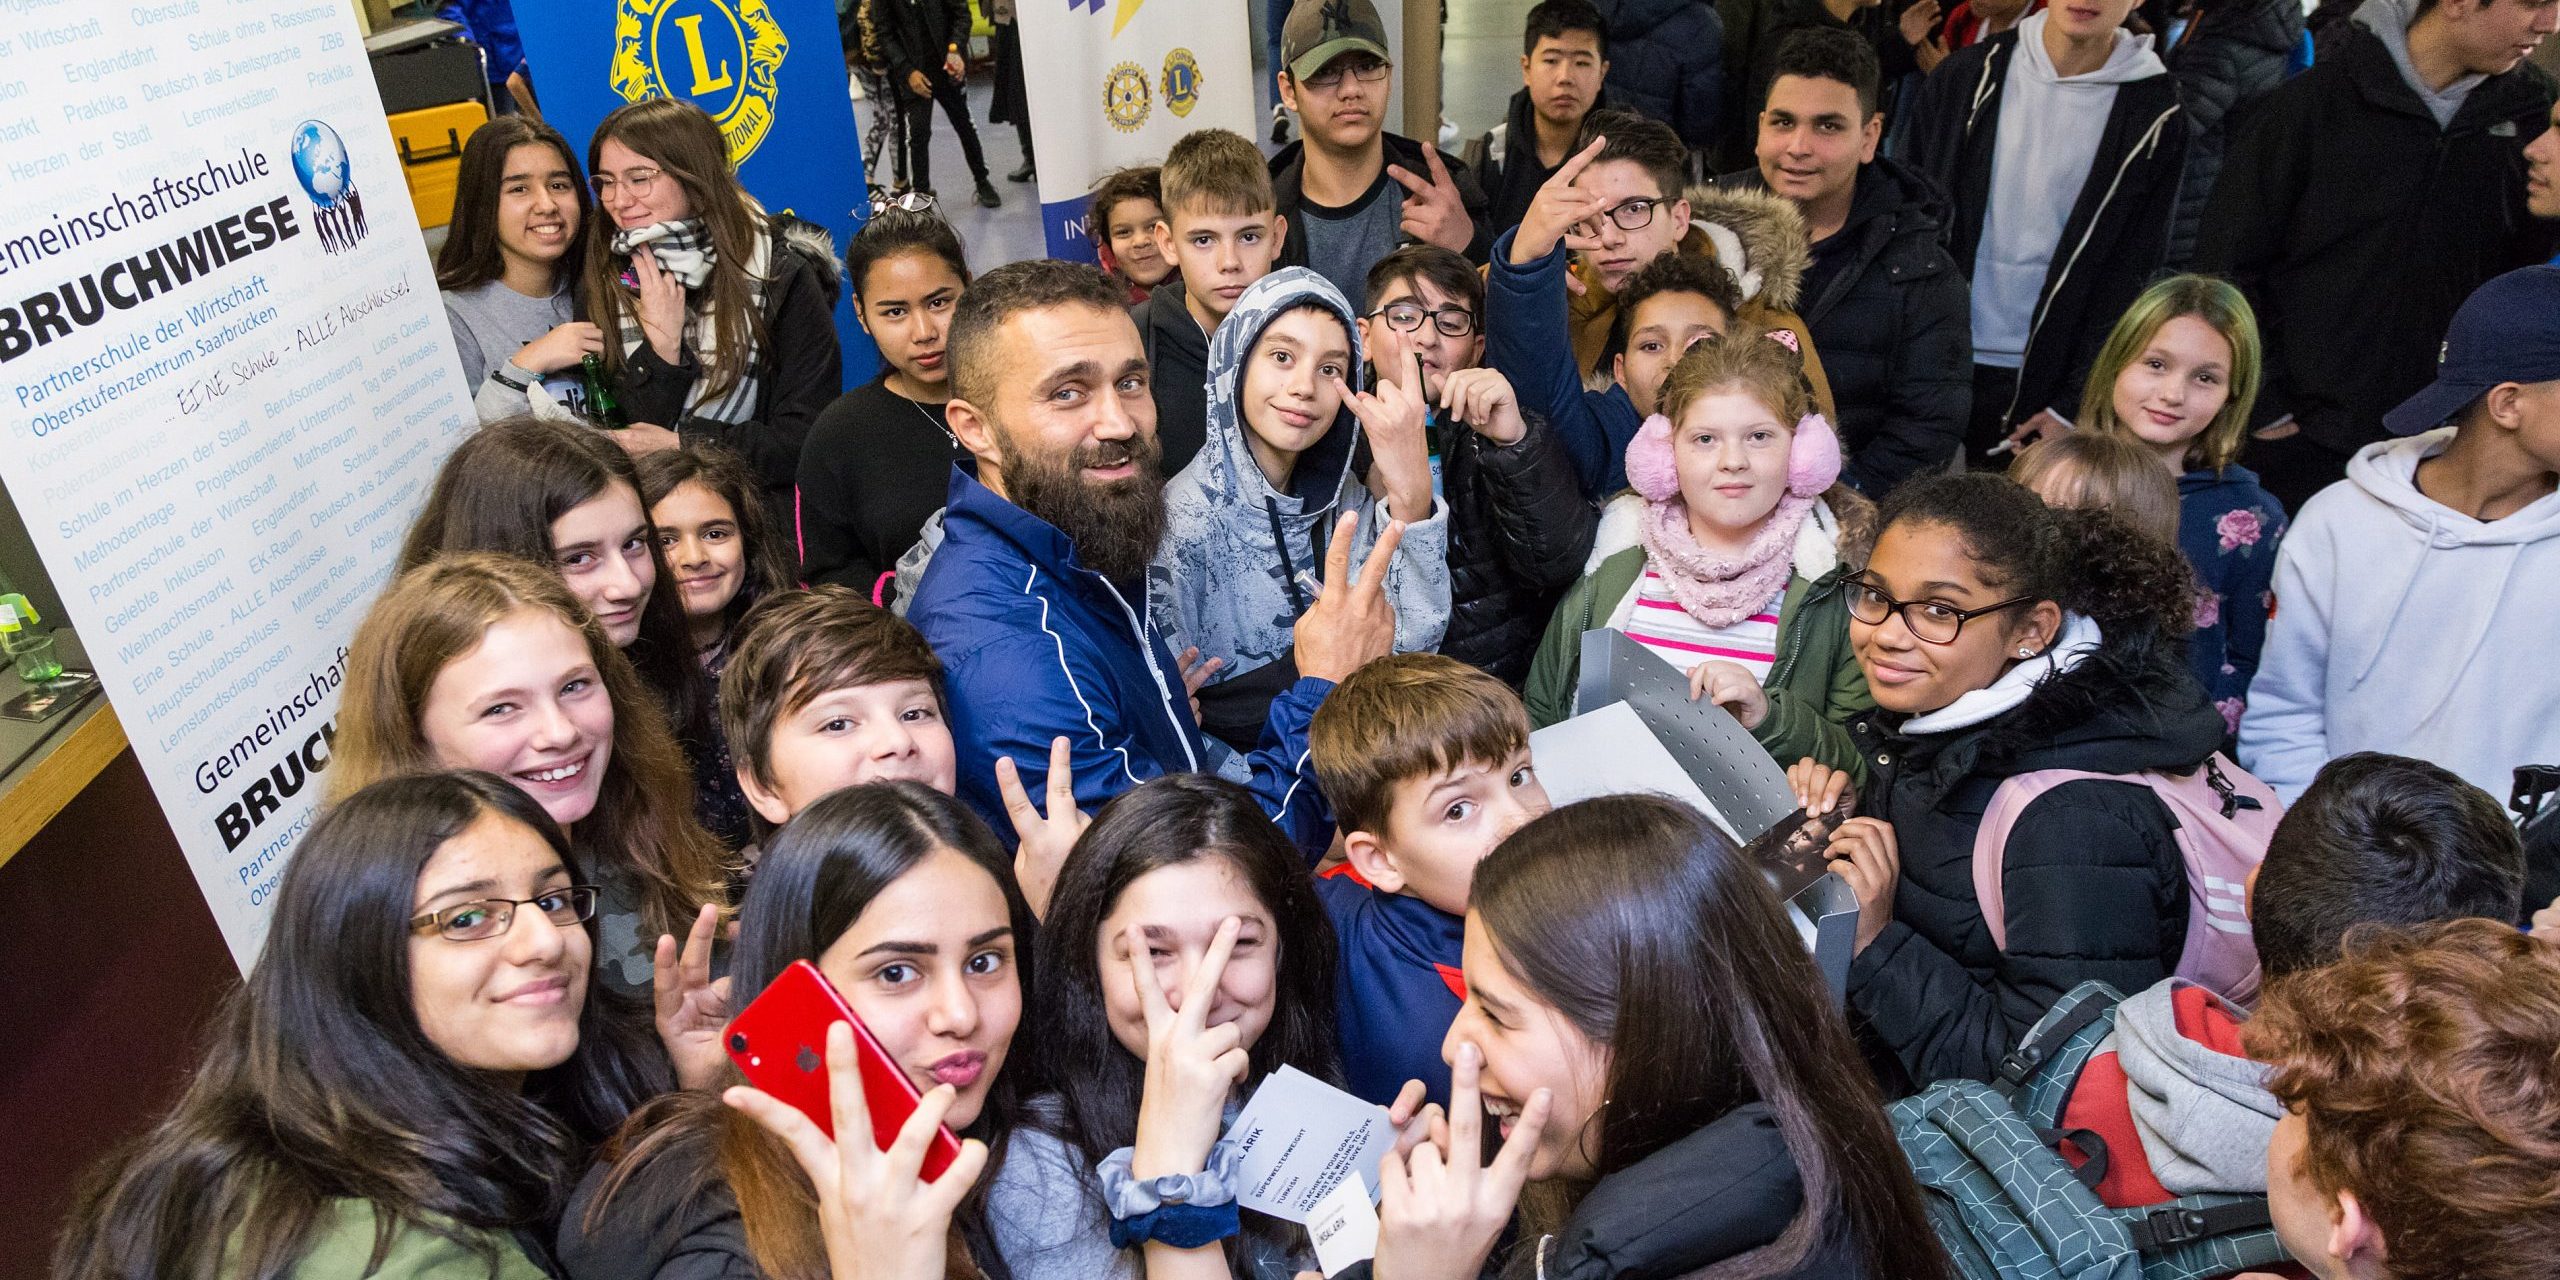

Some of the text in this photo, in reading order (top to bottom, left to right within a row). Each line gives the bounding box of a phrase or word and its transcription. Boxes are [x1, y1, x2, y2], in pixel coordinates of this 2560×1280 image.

[19, 18, 103, 51] Wirtschaft
[130, 1, 200, 27] Oberstufe
[187, 5, 336, 51] Schule ohne Rassismus
[63, 47, 158, 83] Englandfahrt
[142, 32, 344, 102] Deutsch als Zweitsprache ZBB
[307, 65, 354, 88] Praktika
[674, 14, 733, 96] L
[1174, 69, 1188, 96] L
[63, 94, 128, 124] Praktika
[183, 86, 279, 128] Lernwerkstätten
[724, 107, 763, 152] TIONAL
[7, 123, 153, 182] Herzen der Stadt
[0, 195, 300, 364] BRUCHWIESE
[16, 333, 151, 408] Partnerschule
[155, 318, 185, 343] der
[186, 274, 270, 328] Wirtschaft
[177, 371, 230, 415] EINE
[231, 350, 279, 386] Schule
[297, 312, 338, 352] ALLE
[340, 274, 410, 328] Abschlüsse!
[372, 315, 430, 355] Lions Quest
[32, 349, 195, 437] Oberstufenzentrum
[195, 305, 278, 359] Saarbrücken
[264, 356, 363, 419] Berufsorientierung
[361, 340, 439, 395] Tag des Handels
[372, 366, 446, 421] Potenzialanalyse
[195, 392, 356, 498] Projektorientierter Unterricht
[293, 425, 358, 471] Matheraum
[342, 390, 454, 474] Schule ohne Rassismus
[59, 419, 251, 539] Schule im Herzen der Stadt
[310, 490, 355, 529] Deutsch
[359, 481, 374, 497] als
[375, 437, 430, 487] Zweitsprache
[439, 414, 462, 437] ZBB
[252, 479, 319, 536] Englandfahrt
[74, 502, 176, 573] Methodentage
[89, 473, 277, 605] Partnerschule der Wirtschaft
[249, 528, 303, 575] EK-Raum
[370, 523, 400, 554] Abitur
[104, 547, 225, 634] Gelebte Inklusion
[291, 554, 357, 614] Mittlere Reife
[117, 576, 235, 665] Weihnachtsmarkt
[132, 665, 165, 696] Eine
[167, 628, 214, 668] Schule
[230, 589, 266, 625] ALLE
[269, 544, 327, 597] Abschlüsse
[146, 618, 280, 725] Hauptschulabschluss
[159, 644, 293, 753] Lernstandsdiagnosen
[240, 806, 321, 886] Partnersch
[251, 869, 284, 906] Ober
[1242, 1128, 1263, 1153] ARIK
[1256, 1128, 1306, 1198] SUPERWELTERWEIGHT
[1305, 1117, 1373, 1212] YOU MUST BE WILLING TO GIVE
[1333, 1175, 1342, 1185] TO
[1340, 1162, 1351, 1176] NOT
[1349, 1146, 1362, 1161] GIVE
[1277, 1176, 1300, 1204] TURKISH
[1306, 1171, 1328, 1199] ACHIEVE
[1325, 1152, 1340, 1171] YOUR
